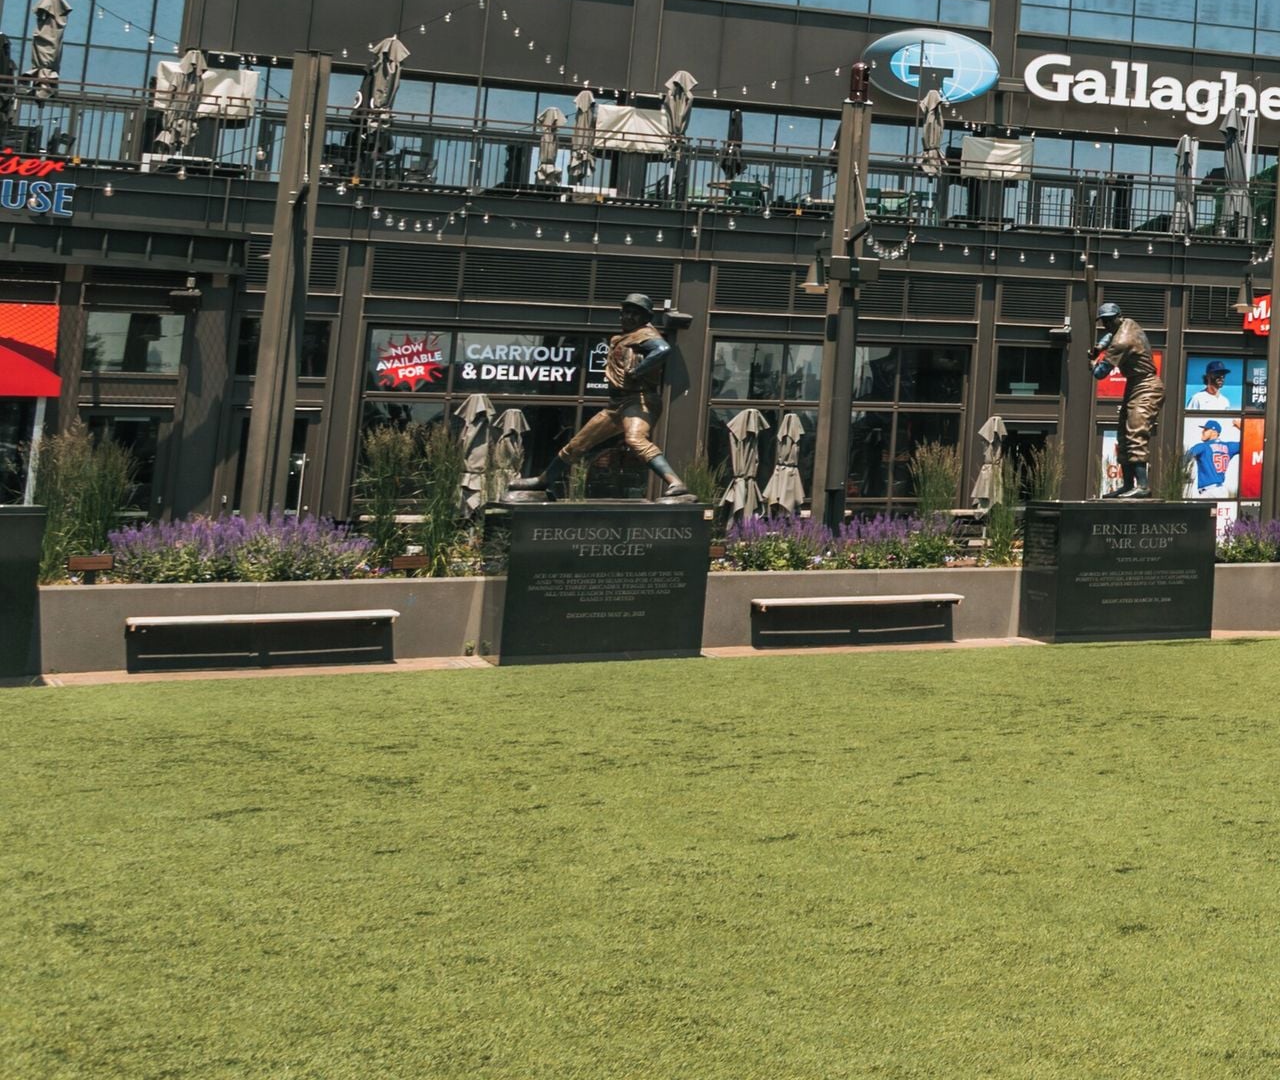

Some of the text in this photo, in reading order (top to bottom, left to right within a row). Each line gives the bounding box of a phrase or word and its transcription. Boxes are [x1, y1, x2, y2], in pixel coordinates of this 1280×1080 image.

[0, 147, 66, 177] iser
[0, 179, 76, 217] USE
[391, 343, 424, 357] NOW
[466, 343, 576, 363] CARRYOUT
[376, 350, 444, 371] AVAILABLE
[397, 365, 425, 380] FOR
[461, 362, 577, 382] & DELIVERY
[531, 526, 693, 544] FERGUSON JENKINS
[1091, 522, 1188, 536] ERNIE BANKS
[571, 543, 654, 558] "FERGIE"
[1106, 537, 1174, 549] "MR. CUB"
